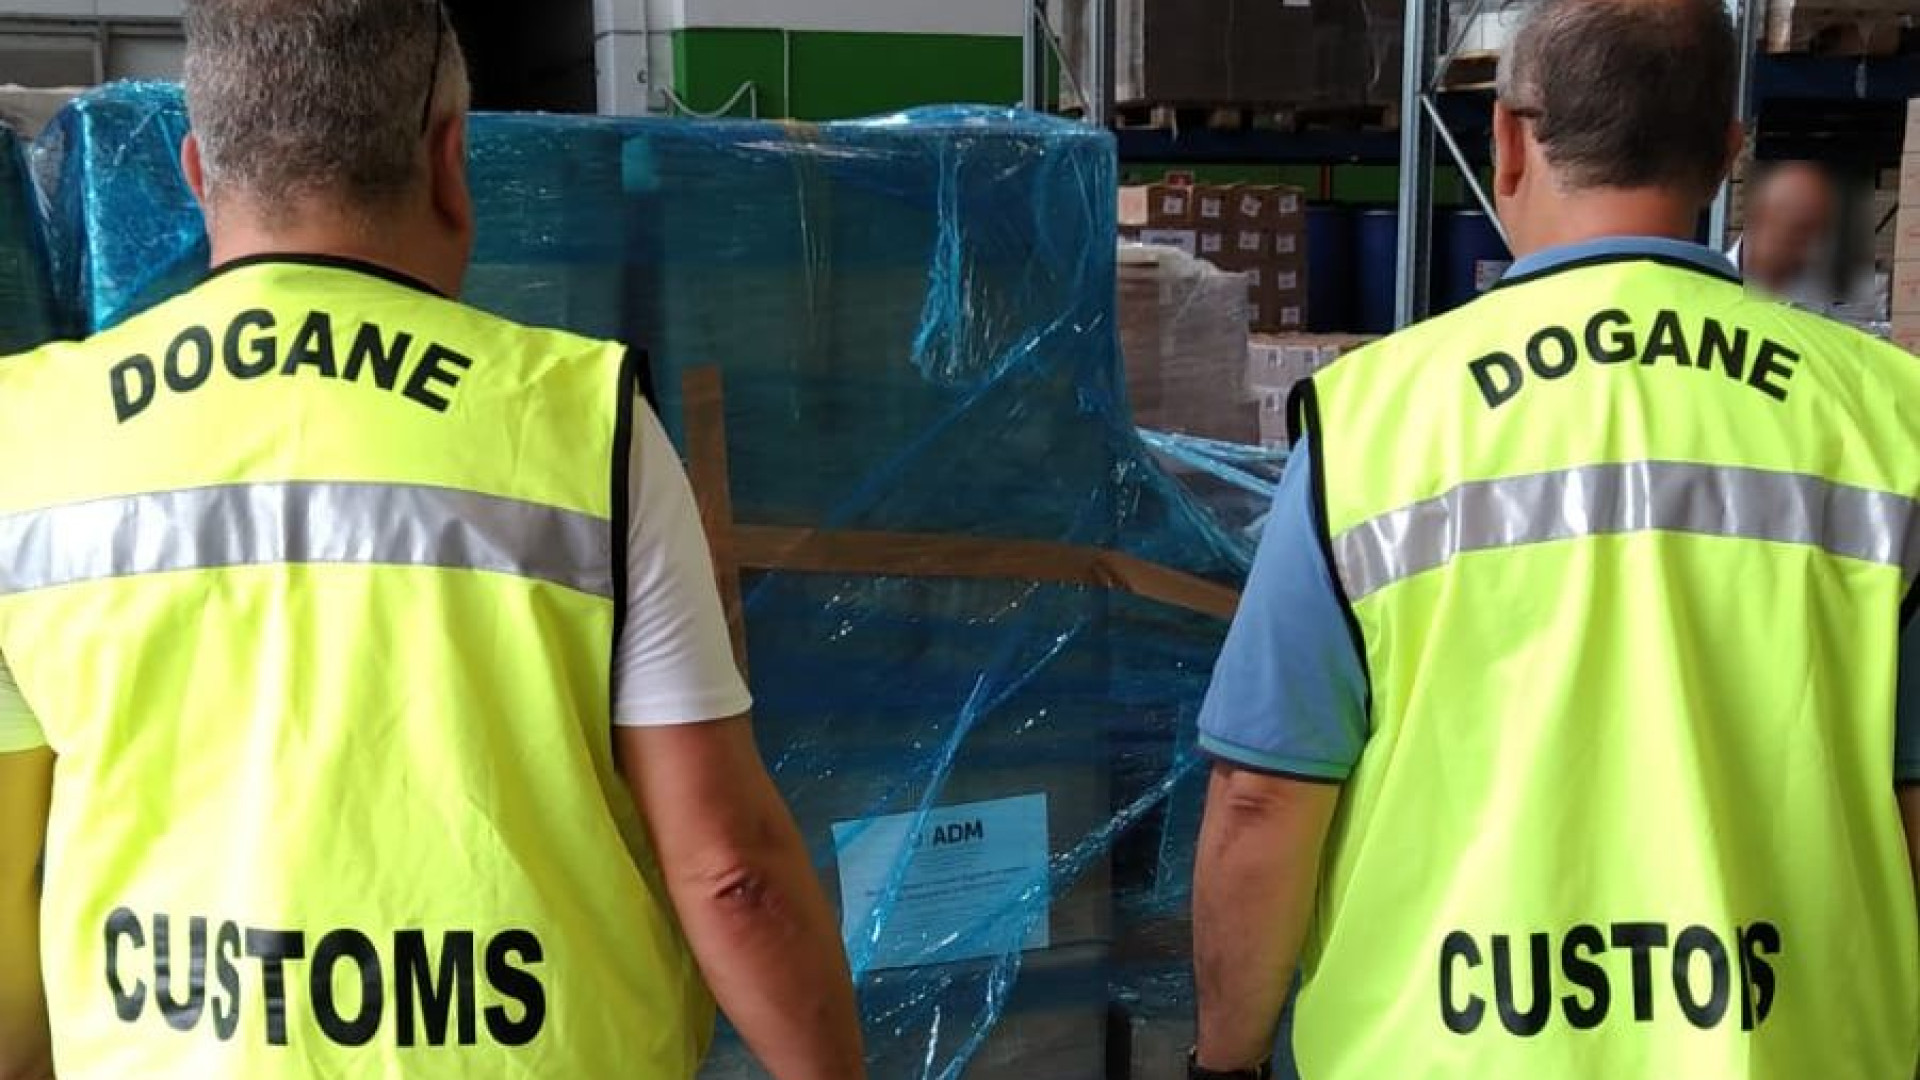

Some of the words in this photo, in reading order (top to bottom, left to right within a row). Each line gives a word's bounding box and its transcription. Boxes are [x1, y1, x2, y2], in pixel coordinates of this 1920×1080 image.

[110, 308, 473, 424] DOGANE
[1468, 308, 1801, 409] DOGANE
[932, 819, 984, 846] ADM
[103, 906, 547, 1048] CUSTOMS
[1439, 921, 1781, 1038] CUSTOS
